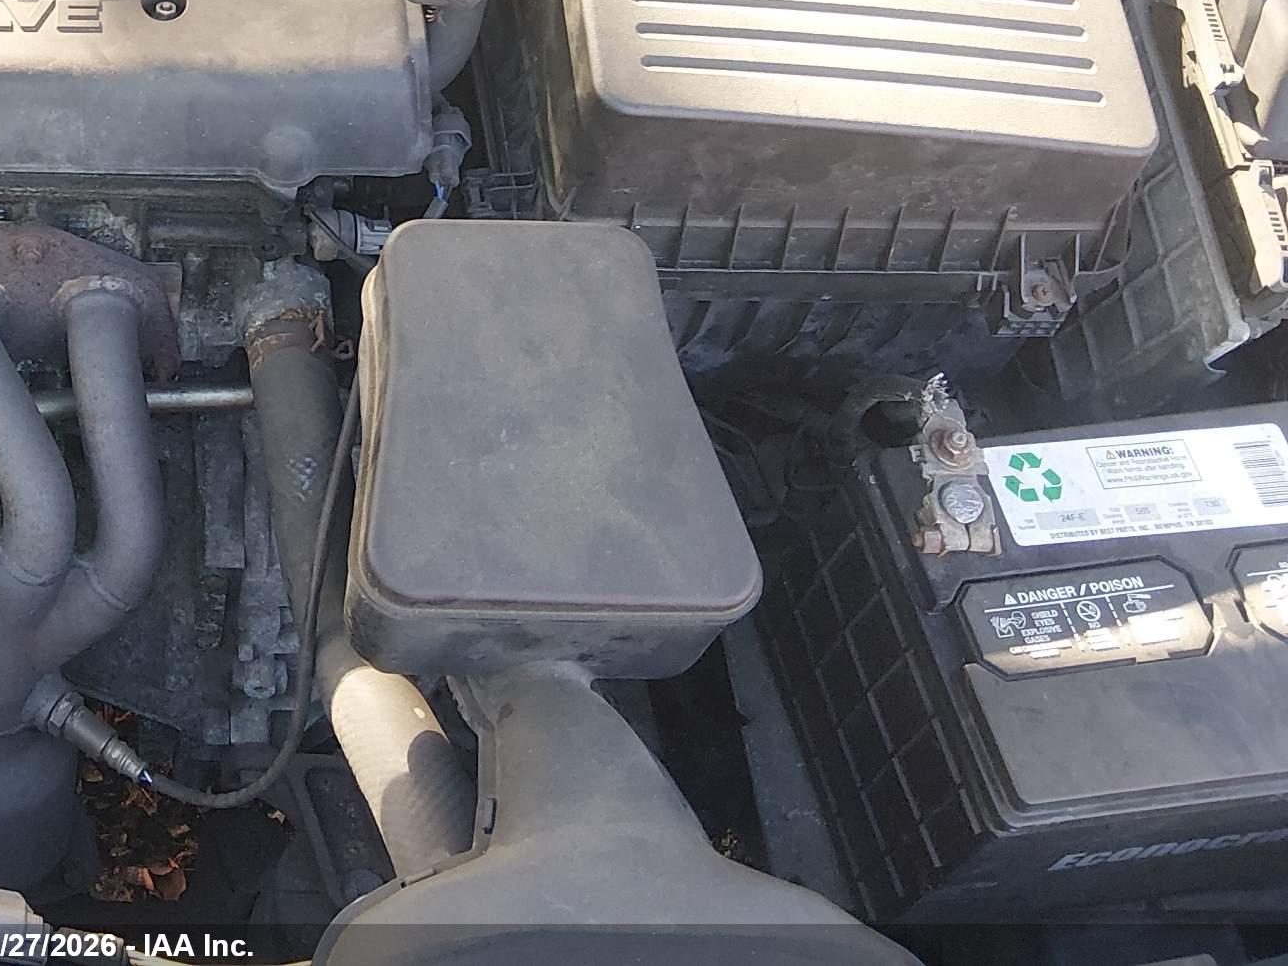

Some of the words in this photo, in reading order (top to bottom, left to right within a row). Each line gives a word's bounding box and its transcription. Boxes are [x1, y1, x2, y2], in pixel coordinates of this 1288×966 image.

[1115, 446, 1175, 459] WARNING:
[1017, 585, 1078, 605] DANGER
[1089, 576, 1145, 594] POISON
[1020, 625, 1063, 637] EXPLOSIVE
